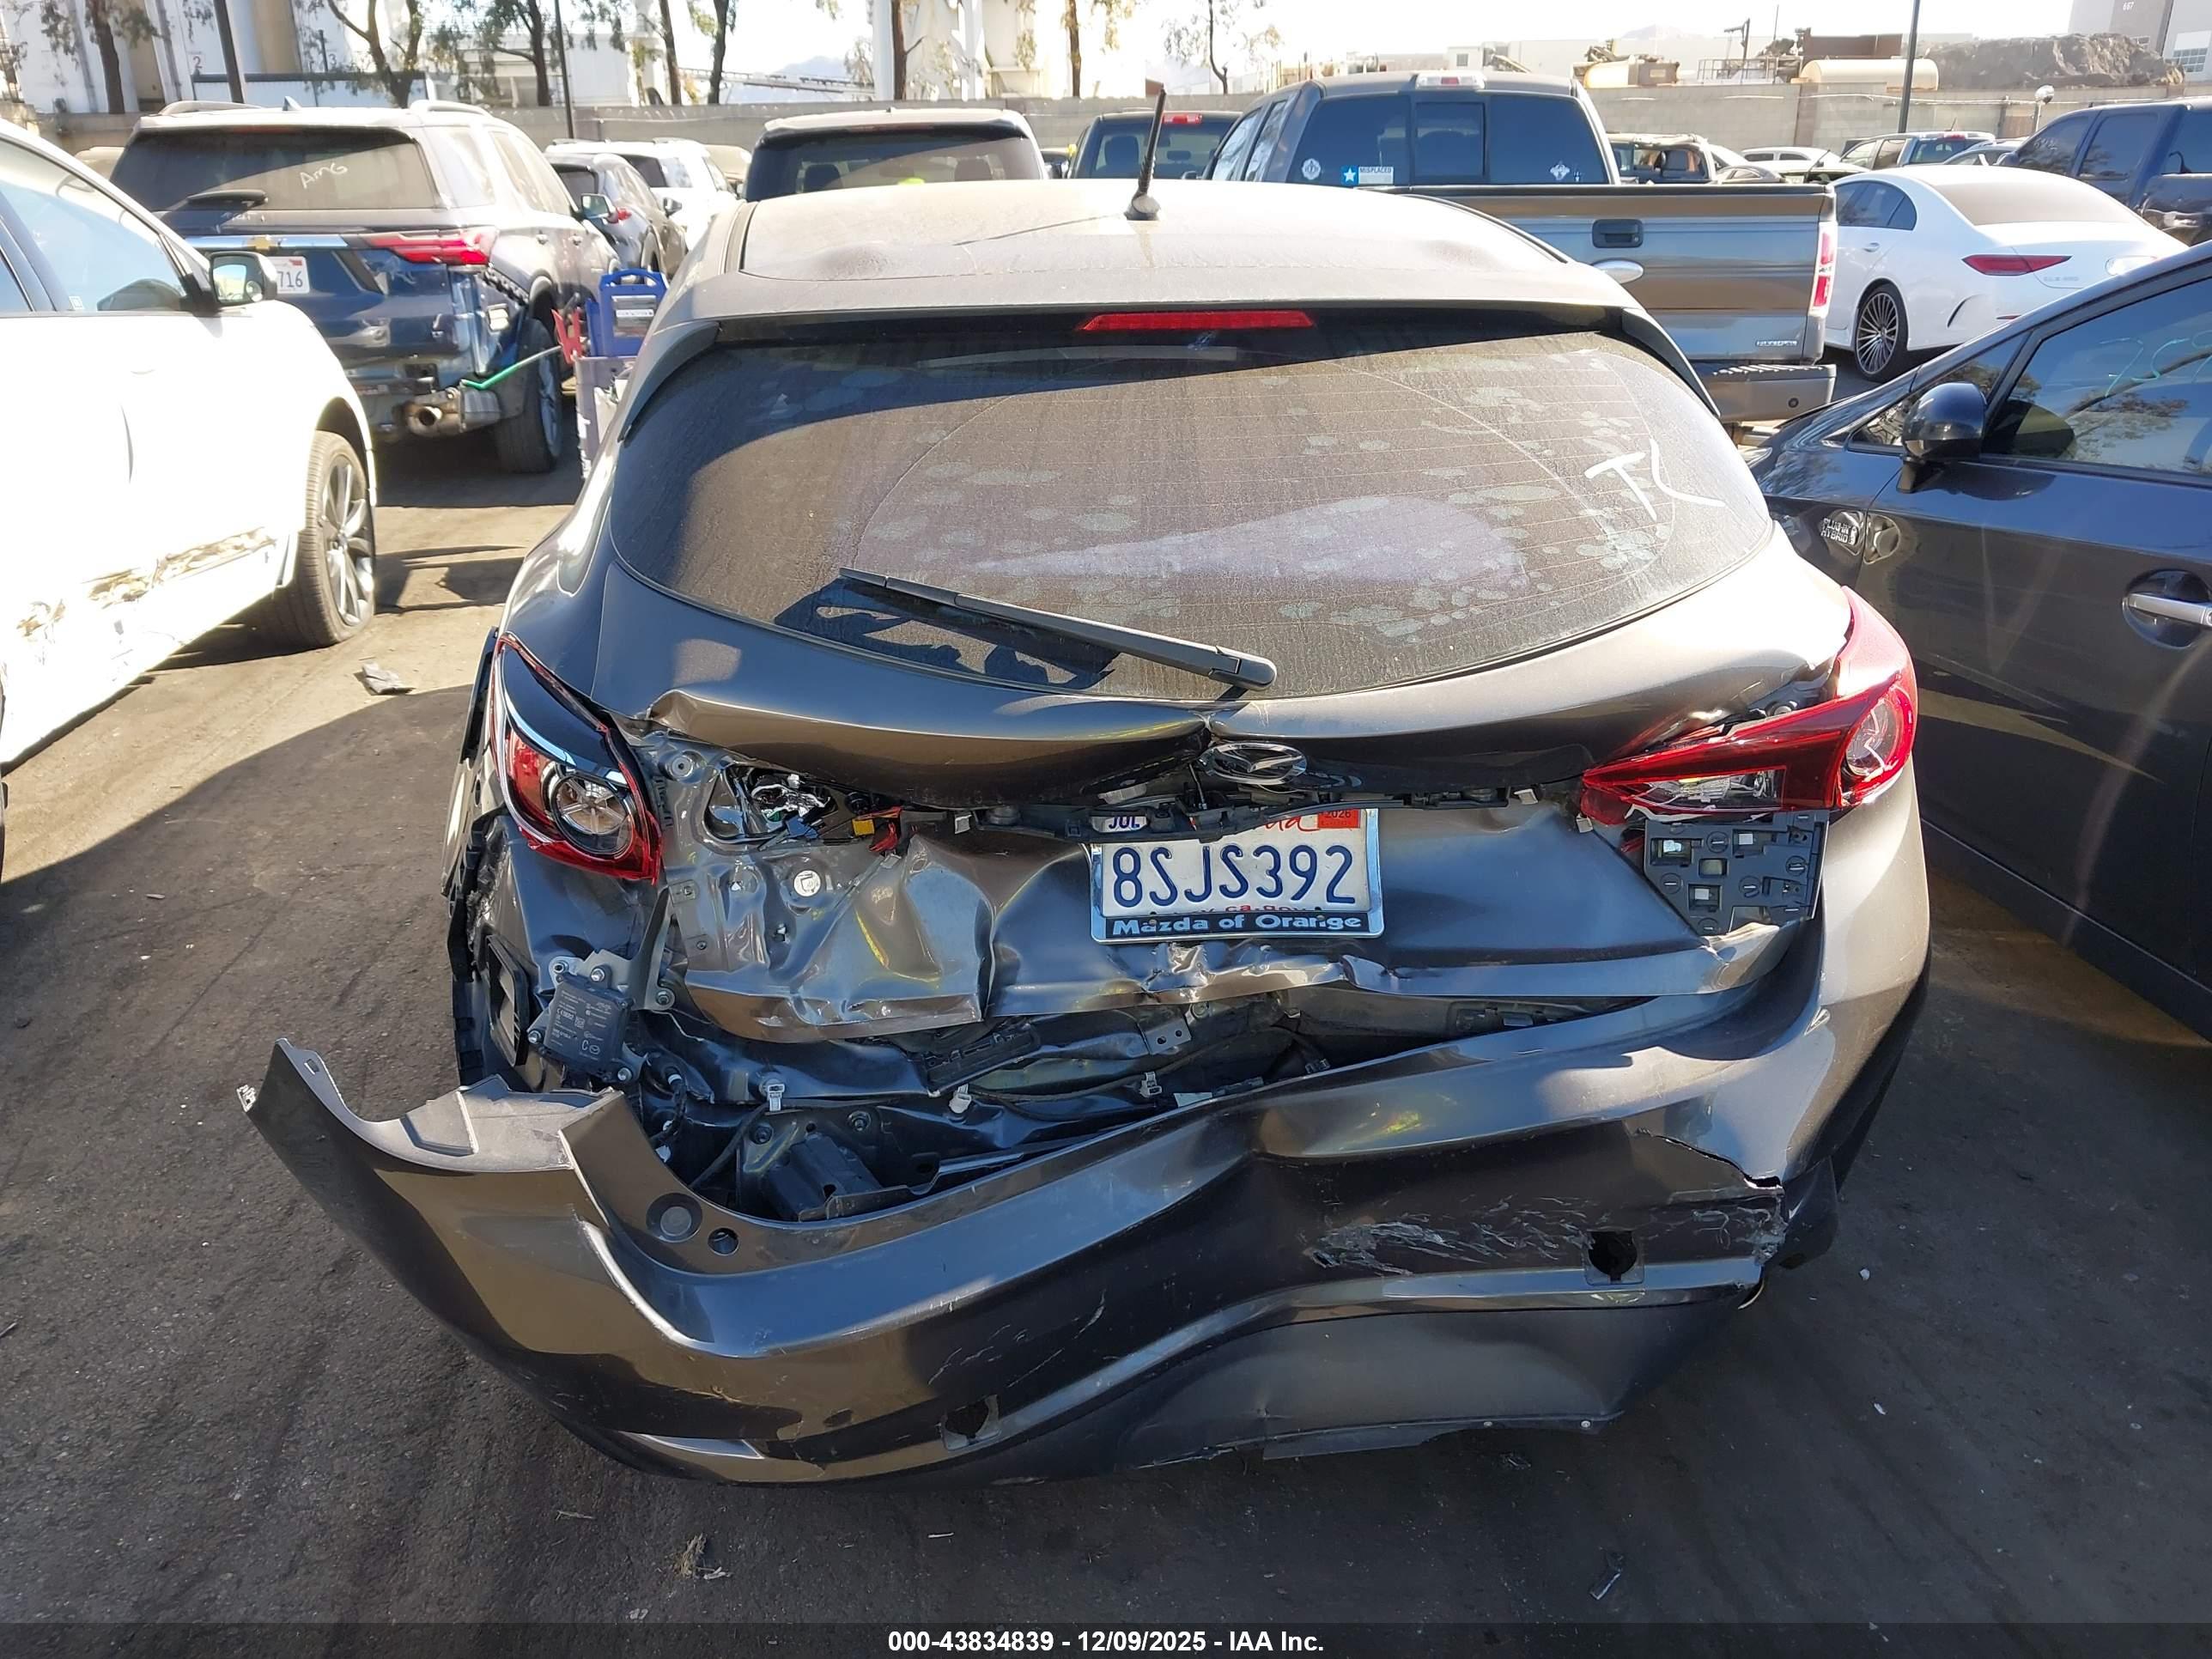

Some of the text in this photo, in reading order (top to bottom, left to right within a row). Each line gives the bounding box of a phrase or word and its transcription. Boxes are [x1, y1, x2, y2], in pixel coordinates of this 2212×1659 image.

[192, 55, 203, 69] 2
[1820, 528, 1849, 544] HYBRID
[1108, 816, 1140, 830] JUL
[1112, 844, 1356, 908] 8SJS392
[1112, 914, 1361, 936] Mazda of Orange
